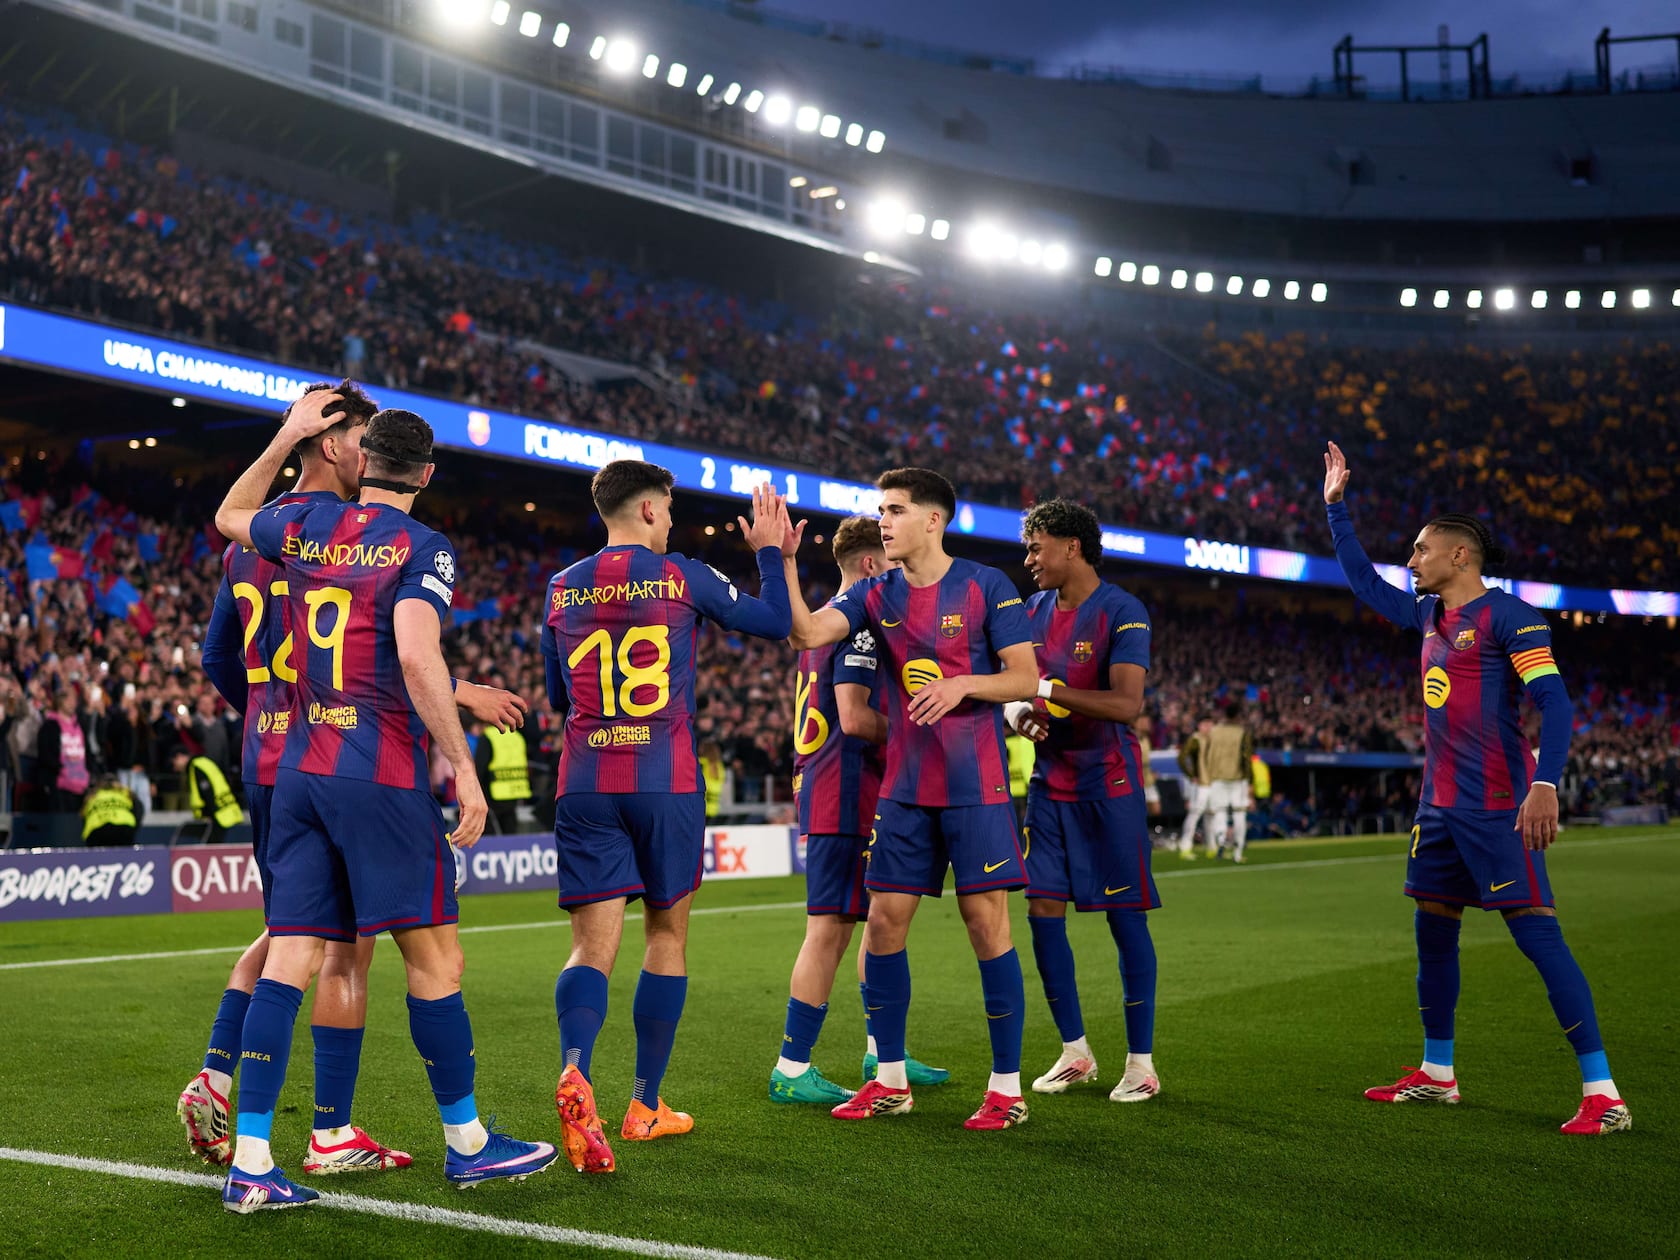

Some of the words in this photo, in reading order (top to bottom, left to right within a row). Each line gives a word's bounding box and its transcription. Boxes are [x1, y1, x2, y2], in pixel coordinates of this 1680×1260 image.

[104, 339, 155, 374] UEFA
[156, 351, 266, 397] CHAMPIONS
[701, 457, 716, 489] 2
[785, 474, 799, 504] 1
[282, 535, 410, 568] EWANDOWSKI
[304, 586, 352, 692] 9
[567, 624, 671, 718] 18
[611, 725, 651, 735] UNHCR
[613, 733, 651, 743] ACNUR
[472, 844, 559, 885] crypto
[703, 831, 748, 873] dEx
[0, 862, 123, 908] BUDAPEST
[119, 861, 155, 899] 26
[171, 855, 264, 902] QATA
